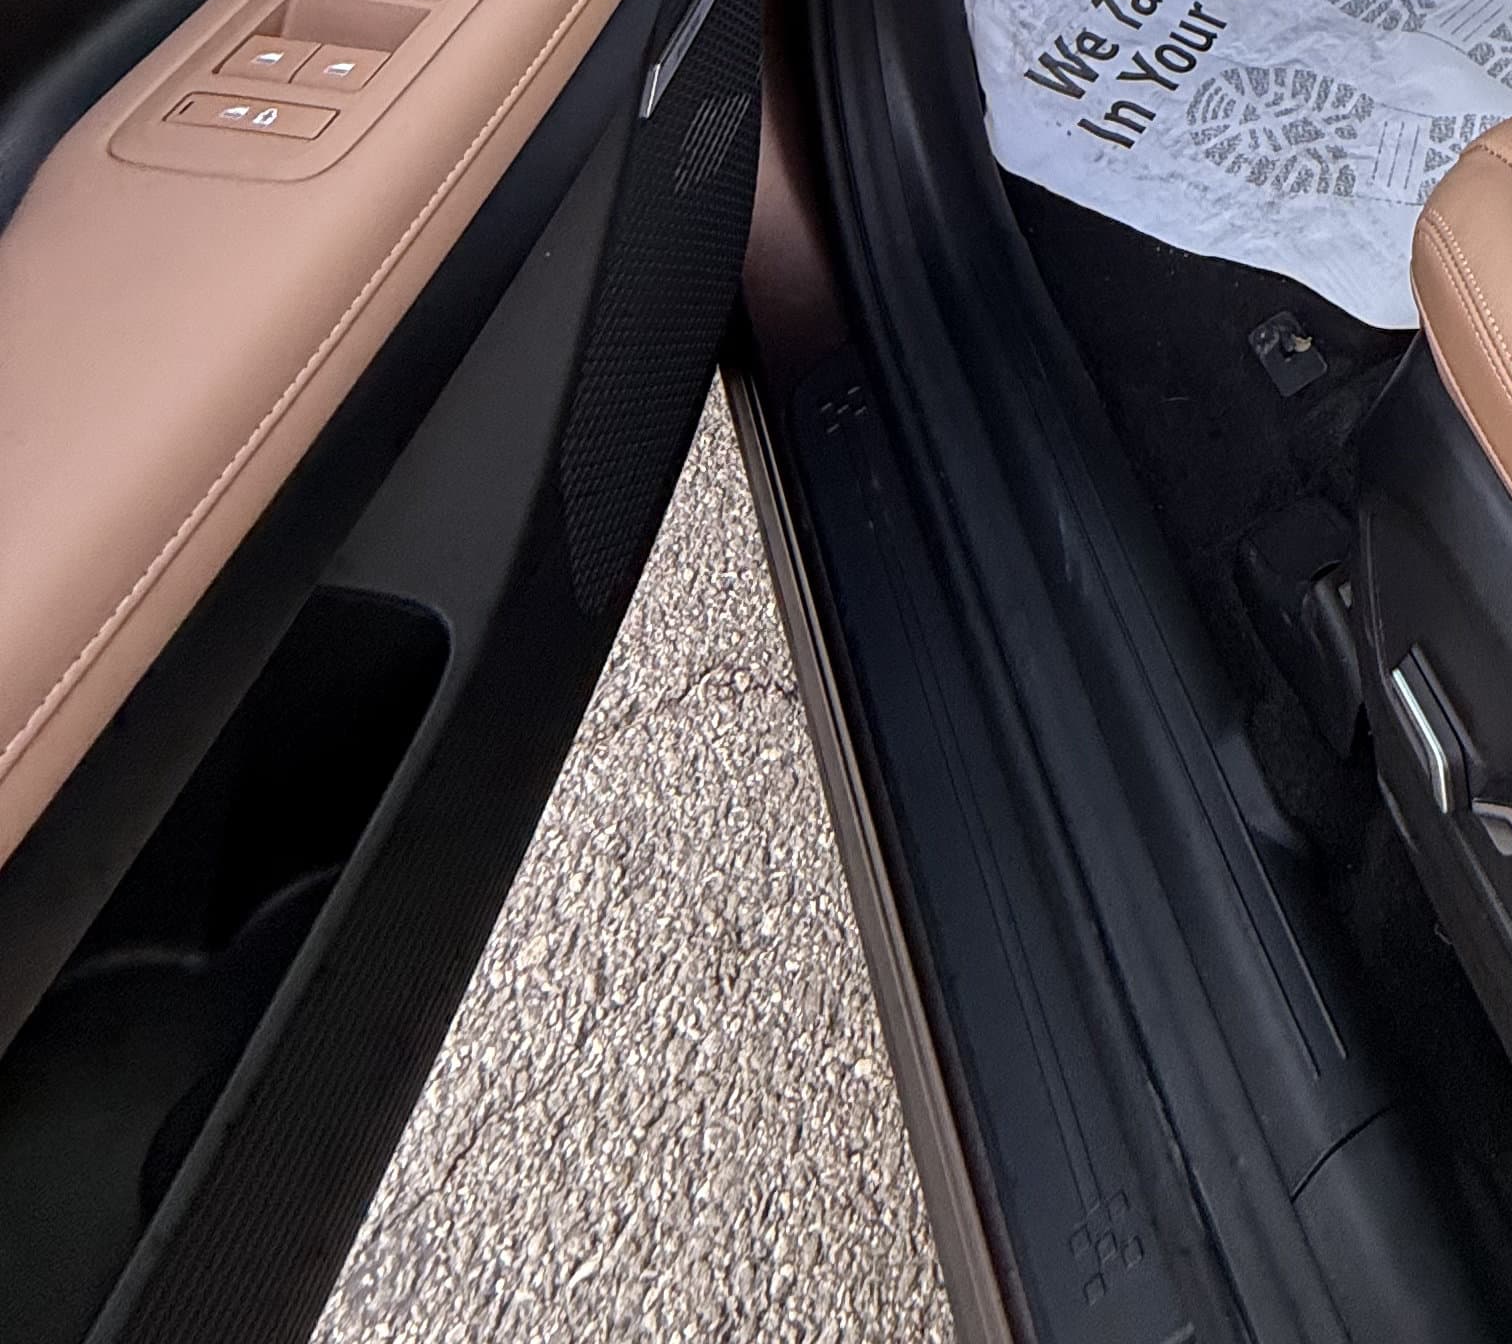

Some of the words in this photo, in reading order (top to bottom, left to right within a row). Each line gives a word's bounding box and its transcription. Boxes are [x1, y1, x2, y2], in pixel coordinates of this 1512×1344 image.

[1024, 28, 1120, 100] We
[1116, 1, 1227, 91] Your
[1077, 100, 1156, 149] In
